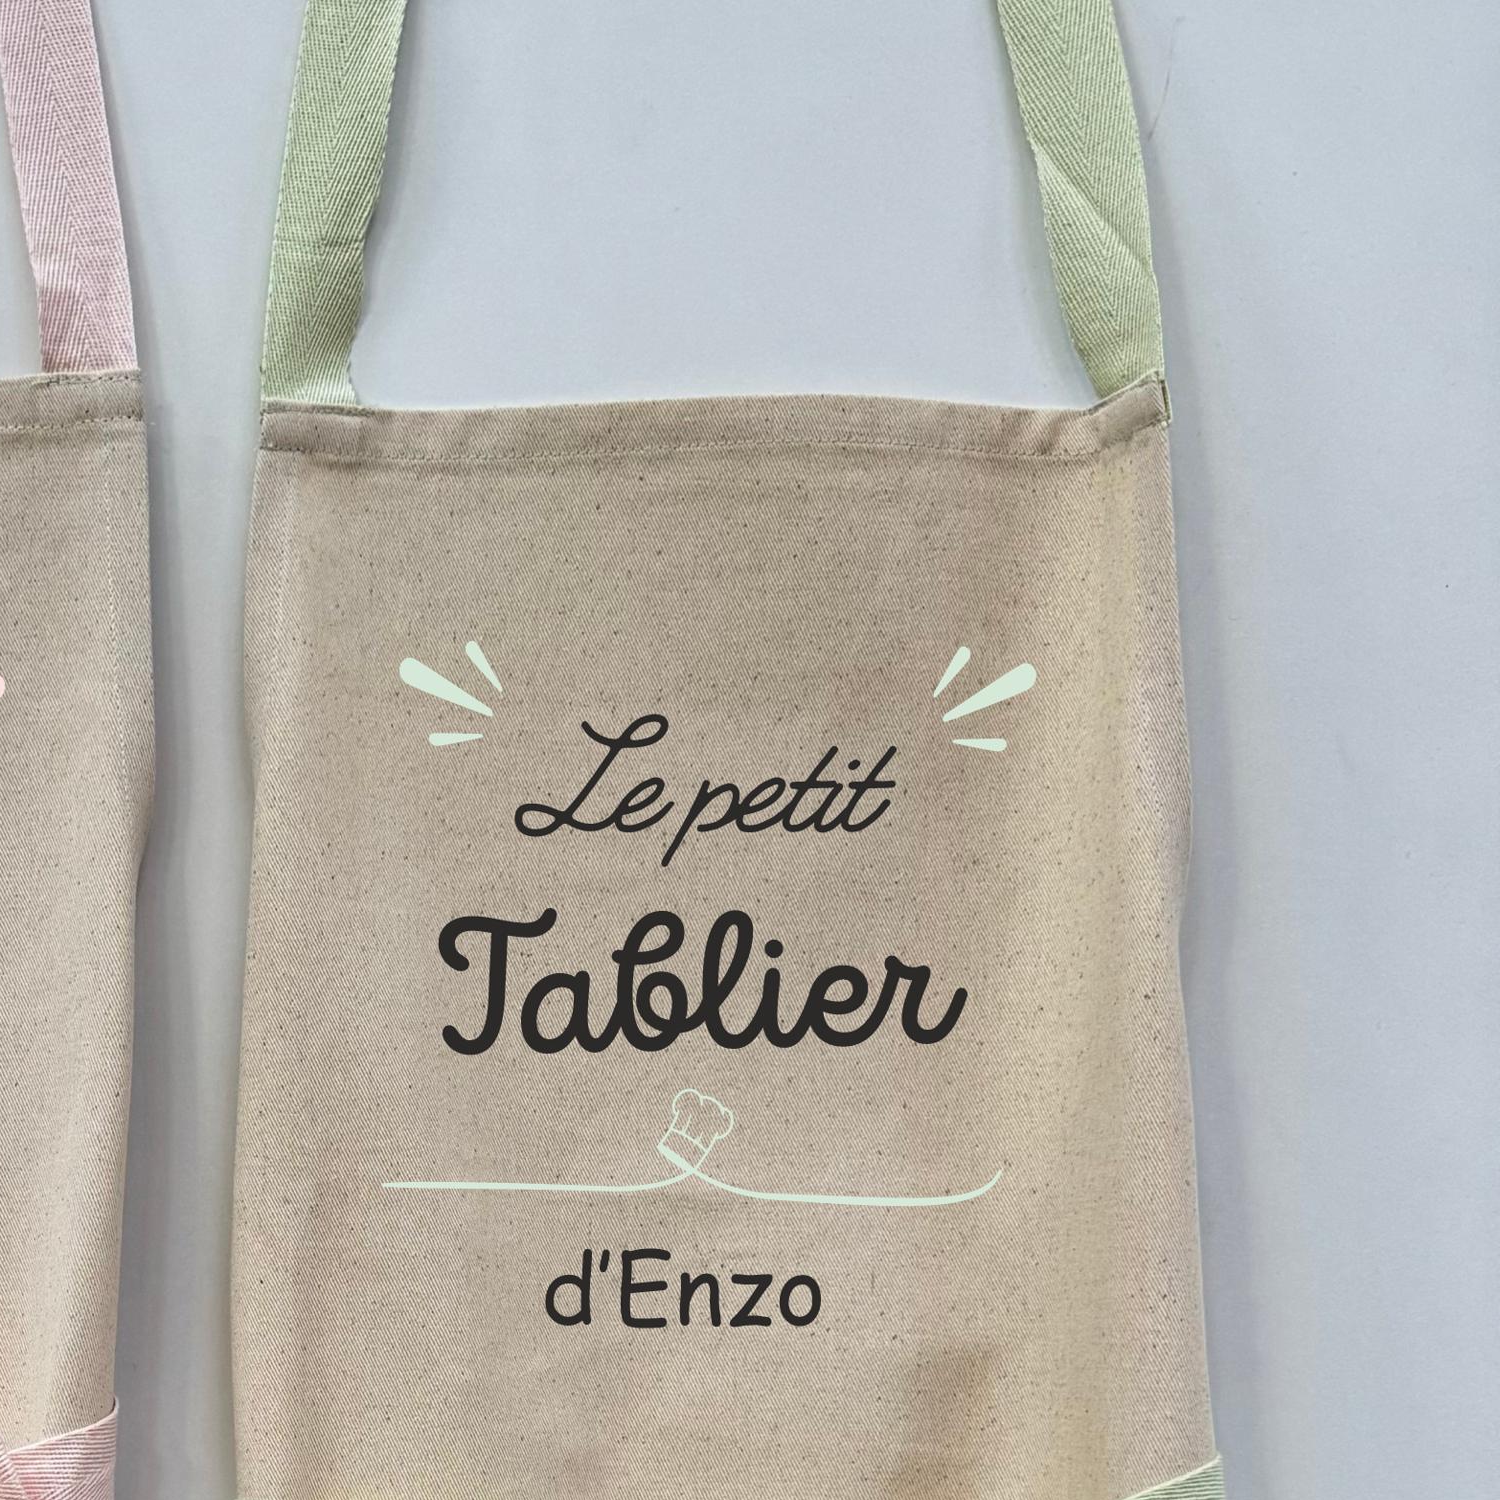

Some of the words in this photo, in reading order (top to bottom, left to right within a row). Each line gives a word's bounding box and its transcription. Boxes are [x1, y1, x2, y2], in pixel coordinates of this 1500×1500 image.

[514, 713, 675, 838] Le
[660, 745, 897, 868] petit
[438, 907, 968, 1056] Tablier
[545, 1248, 822, 1329] d'Enzo
